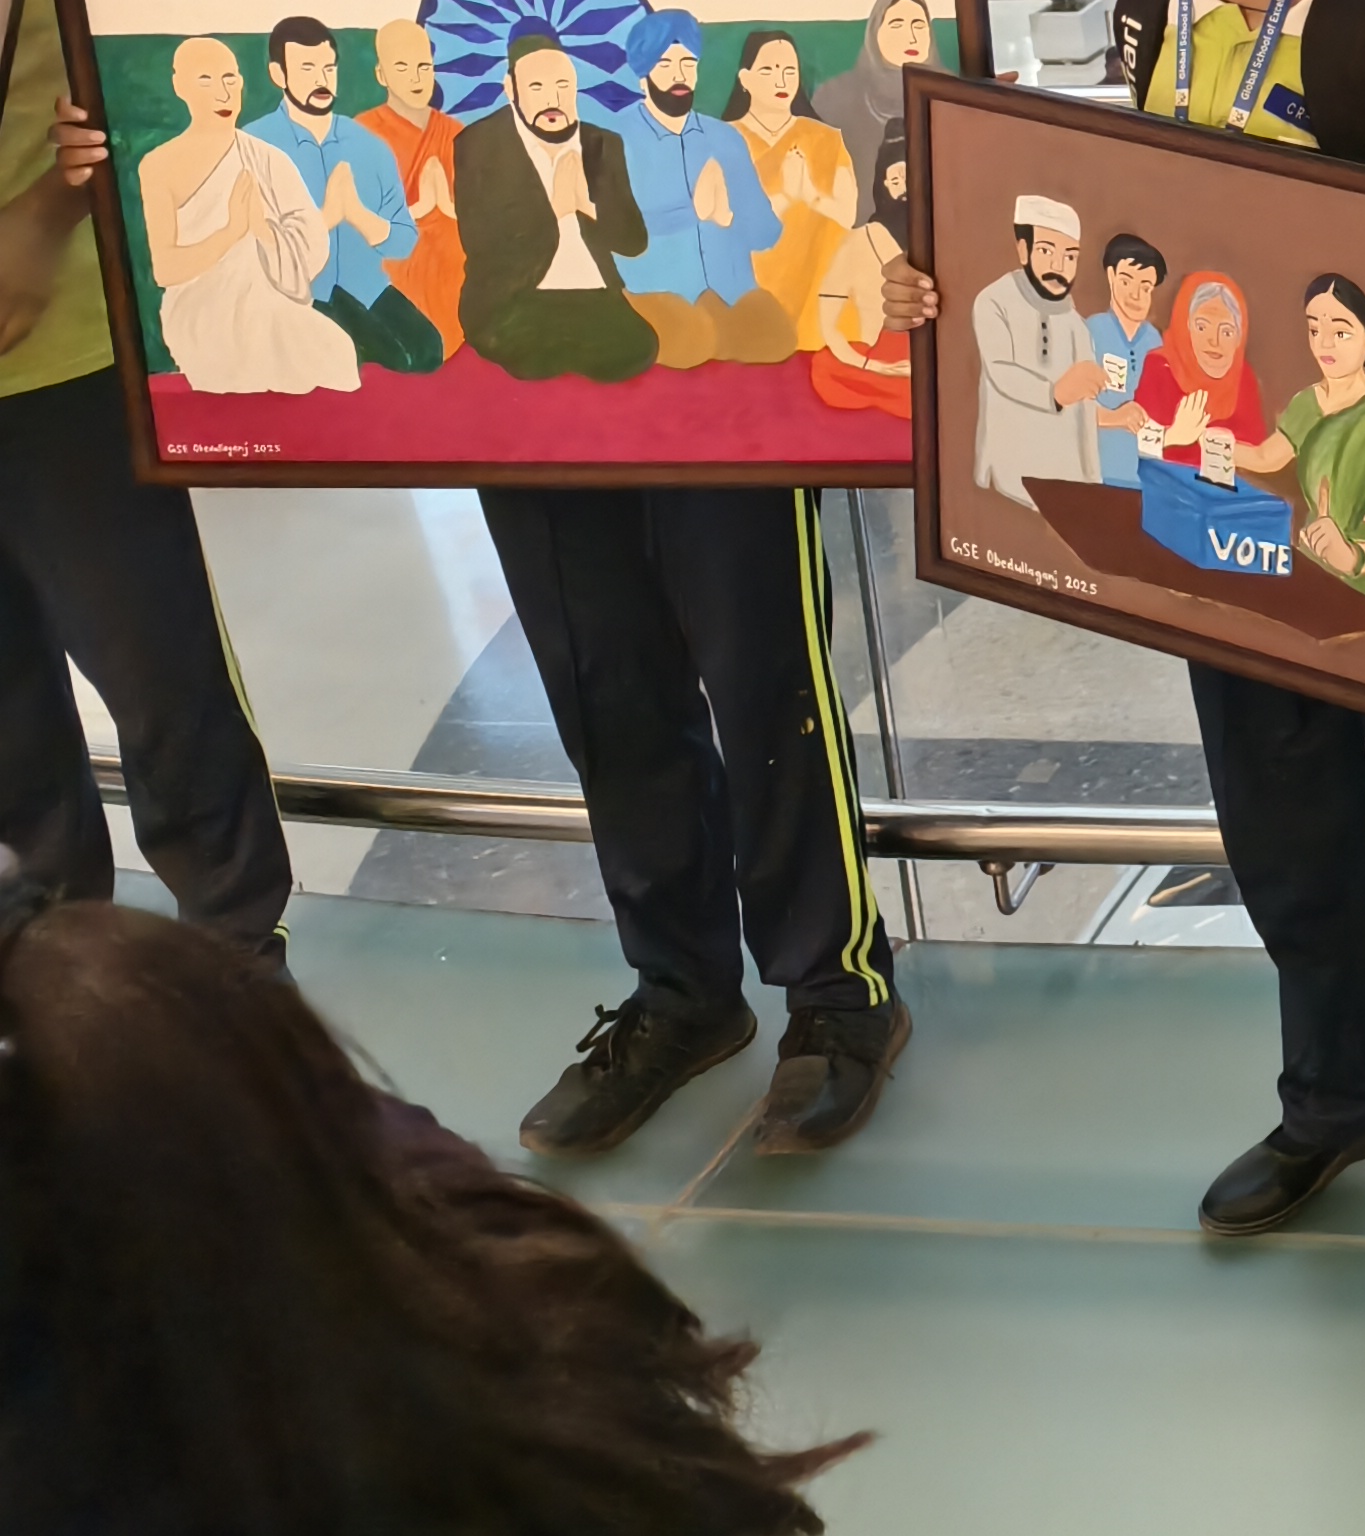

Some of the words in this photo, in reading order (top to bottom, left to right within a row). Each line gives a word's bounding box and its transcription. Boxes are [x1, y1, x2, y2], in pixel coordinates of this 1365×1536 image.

[1180, 0, 1189, 13] of
[1179, 13, 1189, 47] School
[1178, 46, 1188, 81] Global
[1240, 66, 1260, 101] Global
[1251, 34, 1271, 68] School
[1266, 23, 1276, 36] of
[950, 537, 979, 560] GSE
[1064, 574, 1098, 596] 2025
[1207, 528, 1293, 576] VOTE
